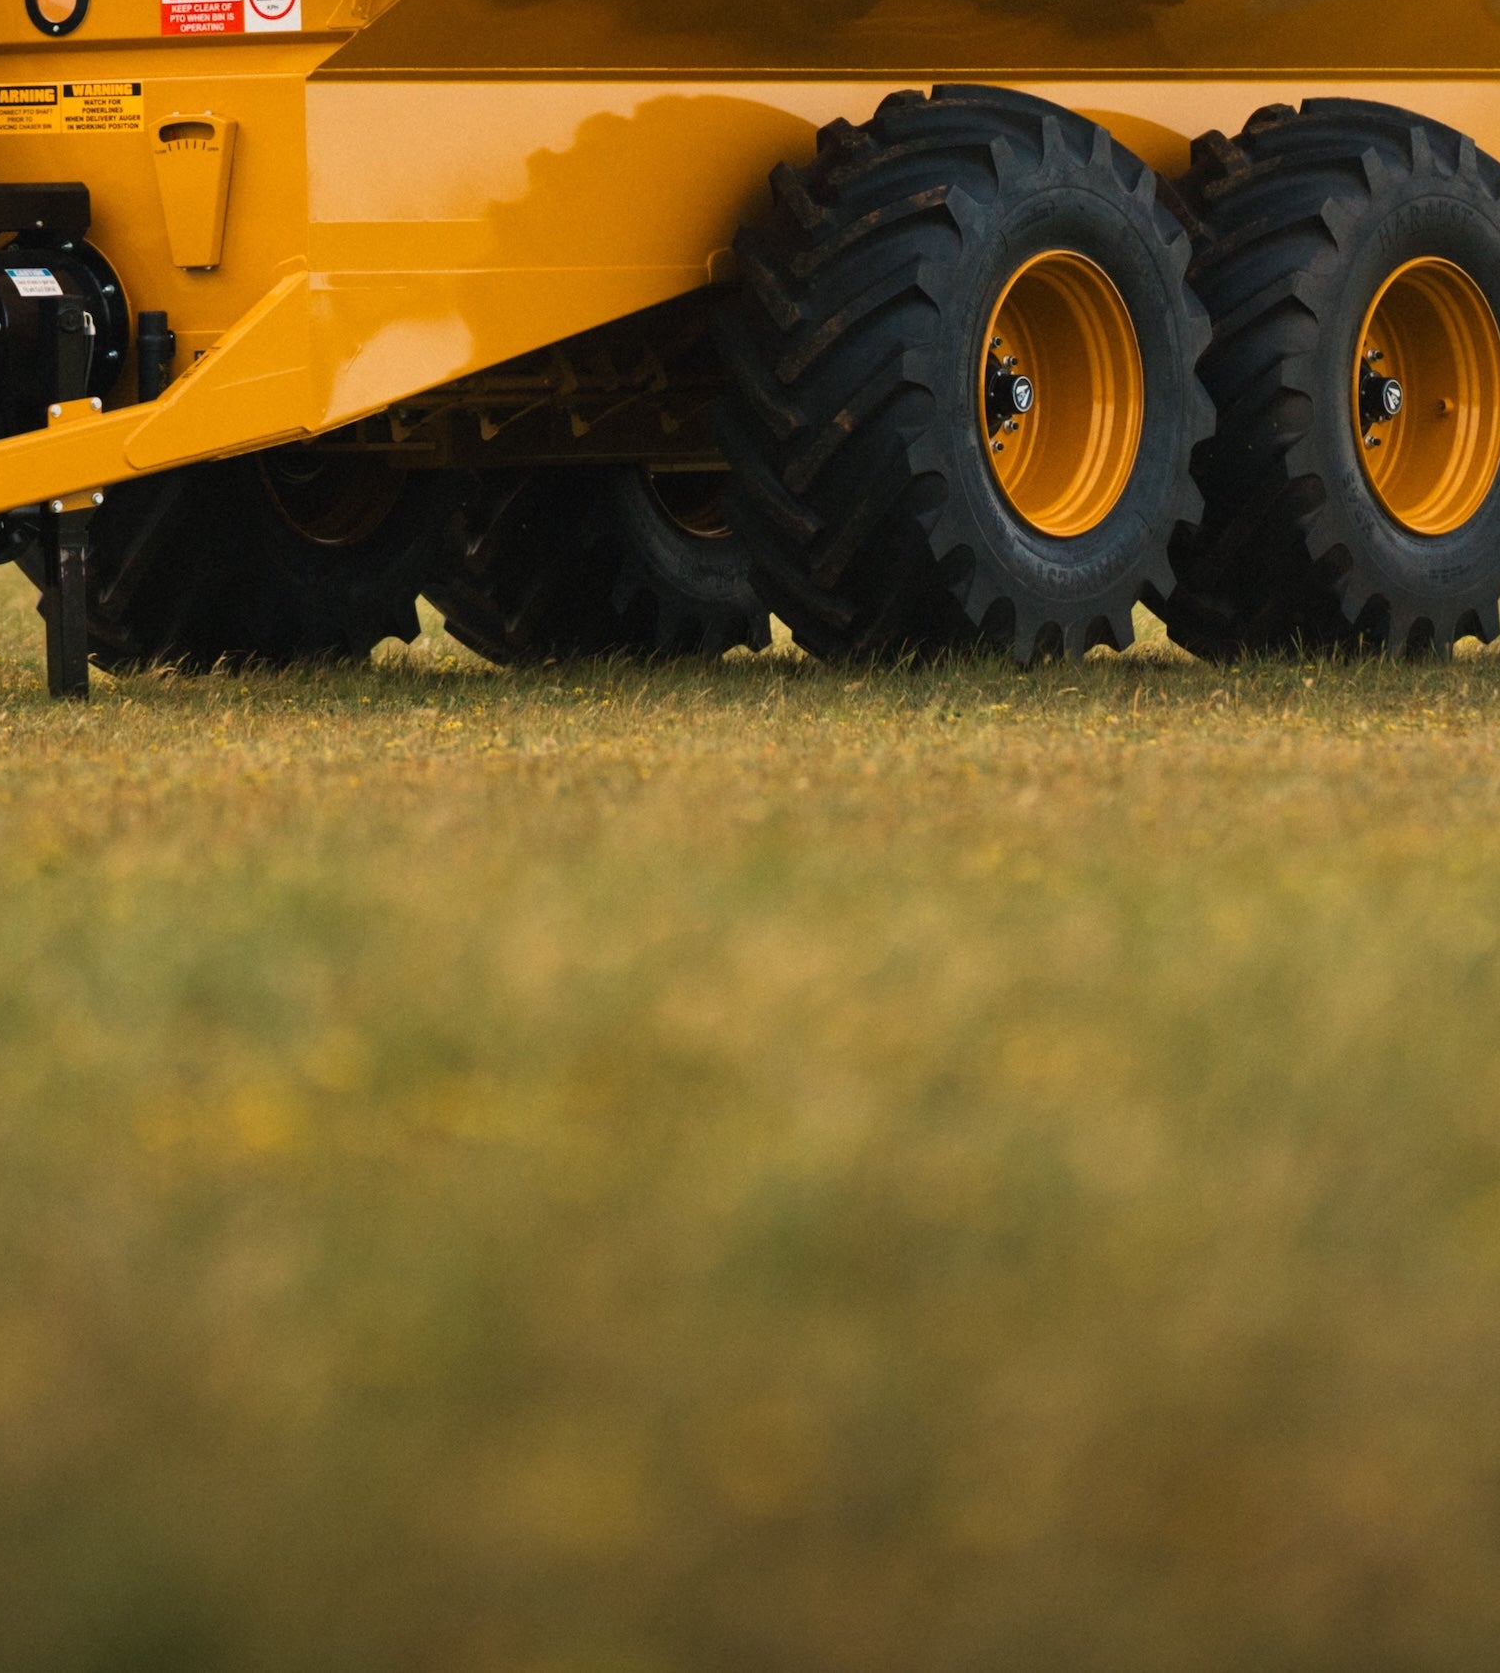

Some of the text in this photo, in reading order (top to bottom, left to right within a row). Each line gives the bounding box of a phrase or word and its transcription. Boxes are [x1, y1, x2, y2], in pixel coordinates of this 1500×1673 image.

[171, 2, 233, 13] KEEP CLEAR OF
[170, 12, 234, 23] PTO WHEN BIN IS
[180, 23, 225, 32] OPERATING
[71, 83, 133, 96] WARNING
